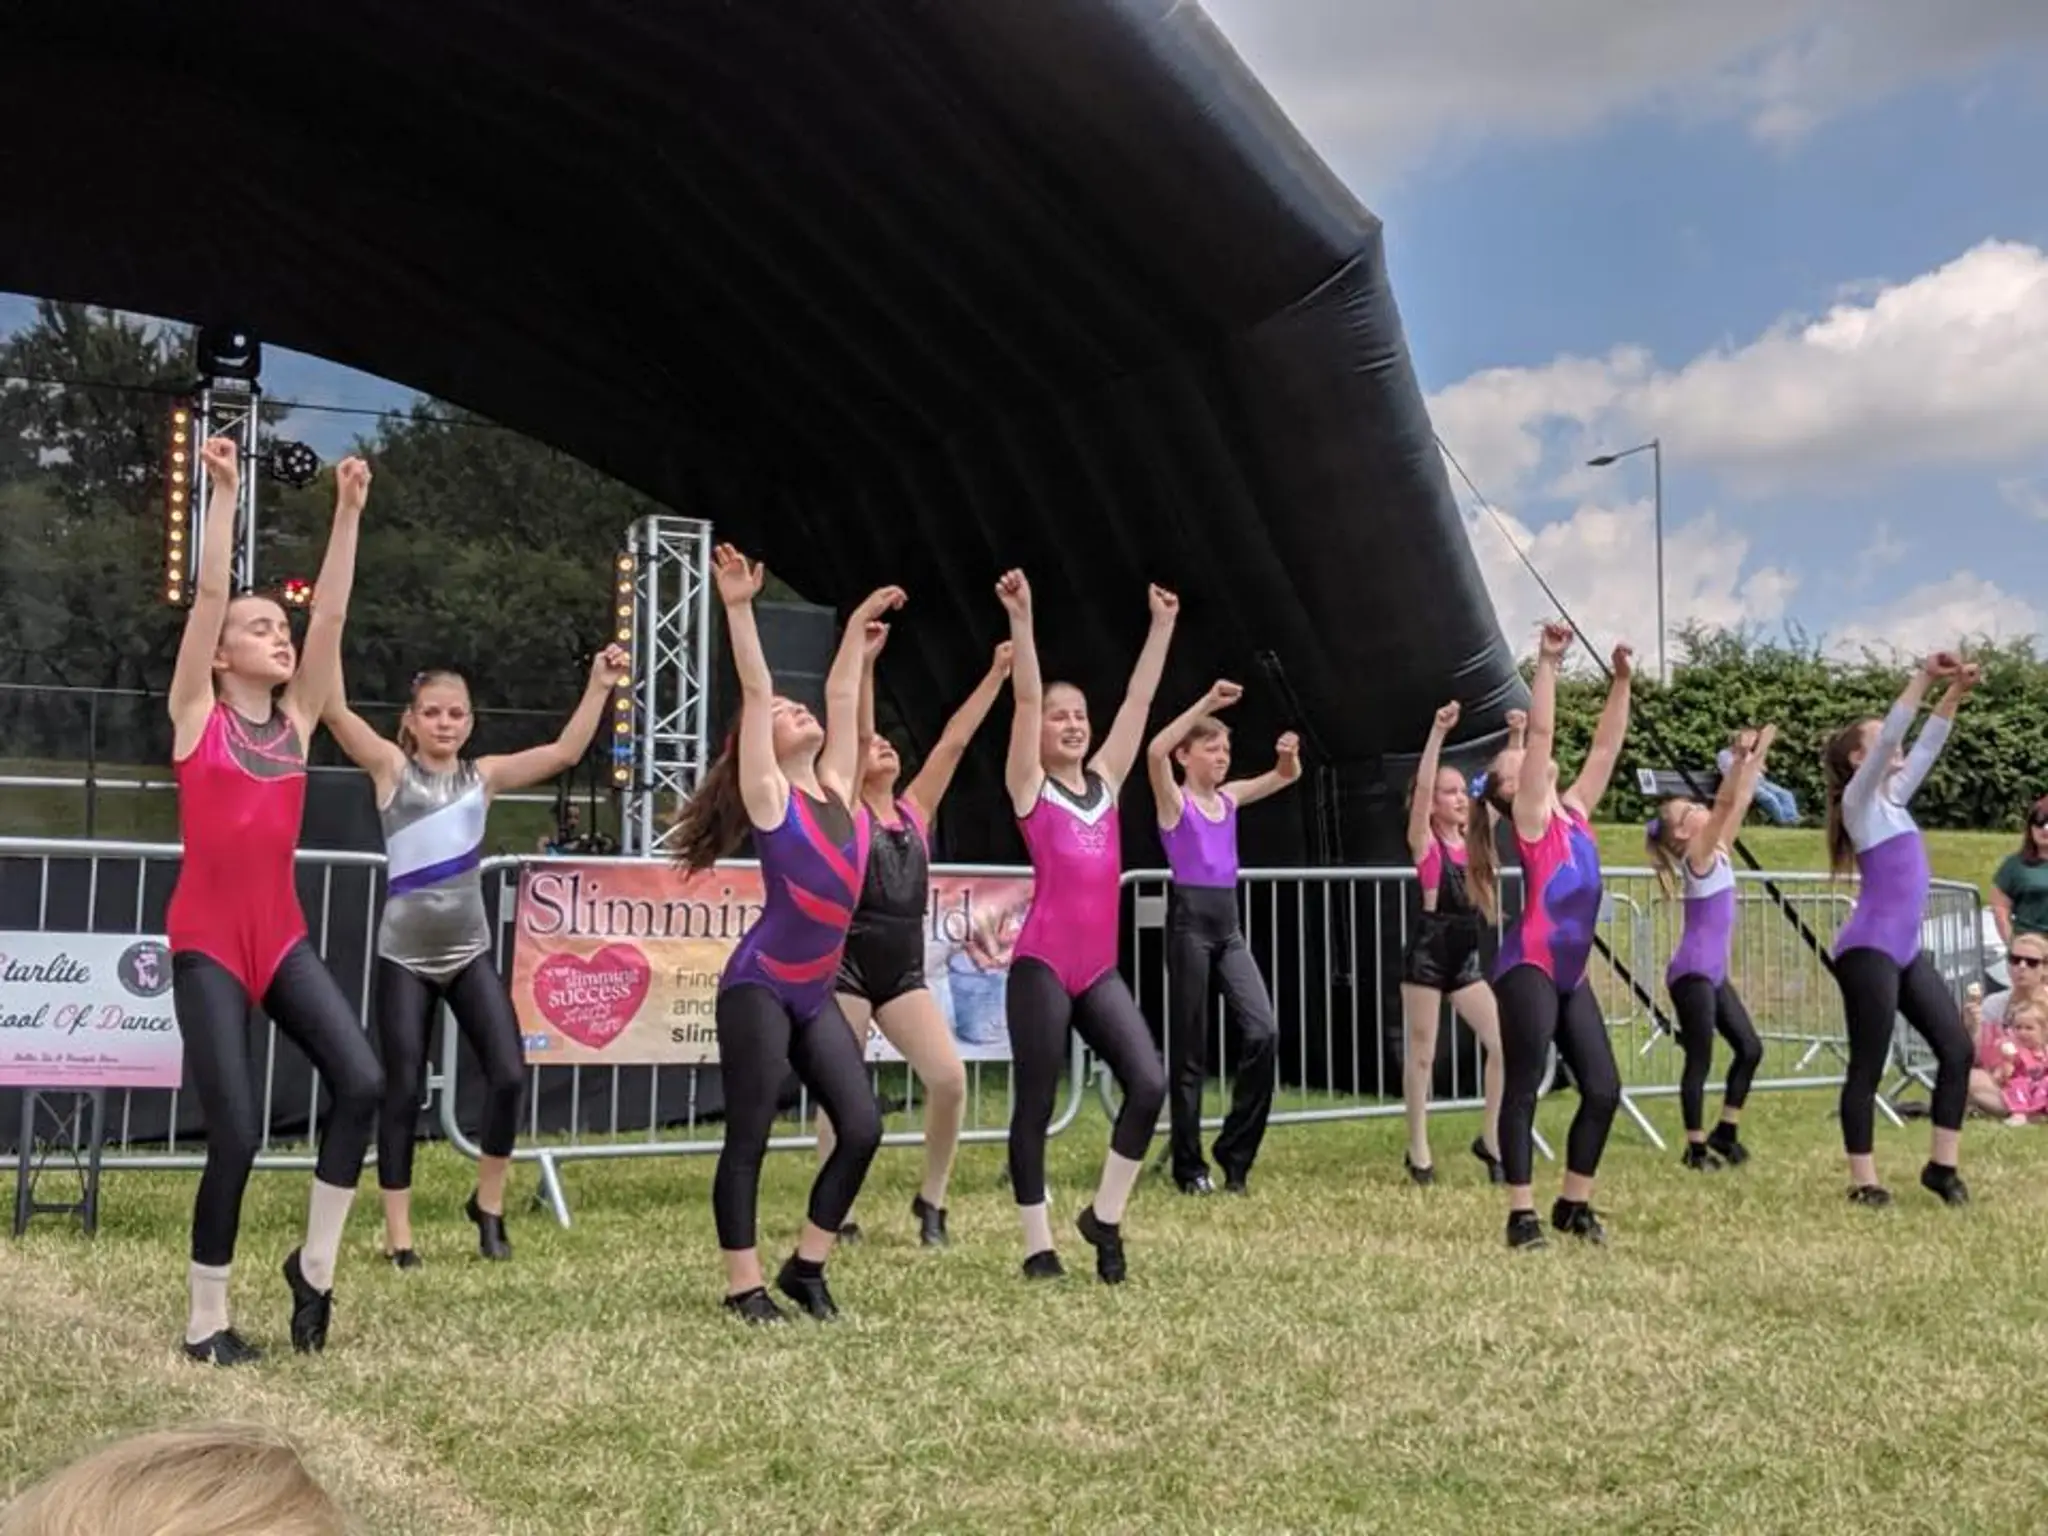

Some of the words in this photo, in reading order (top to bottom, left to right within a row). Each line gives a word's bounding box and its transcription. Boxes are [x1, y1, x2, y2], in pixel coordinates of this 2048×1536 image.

[527, 872, 766, 938] Slimmin
[547, 984, 631, 1008] success
[673, 996, 714, 1016] and
[54, 1004, 94, 1036] Of
[95, 1004, 173, 1032] Dance
